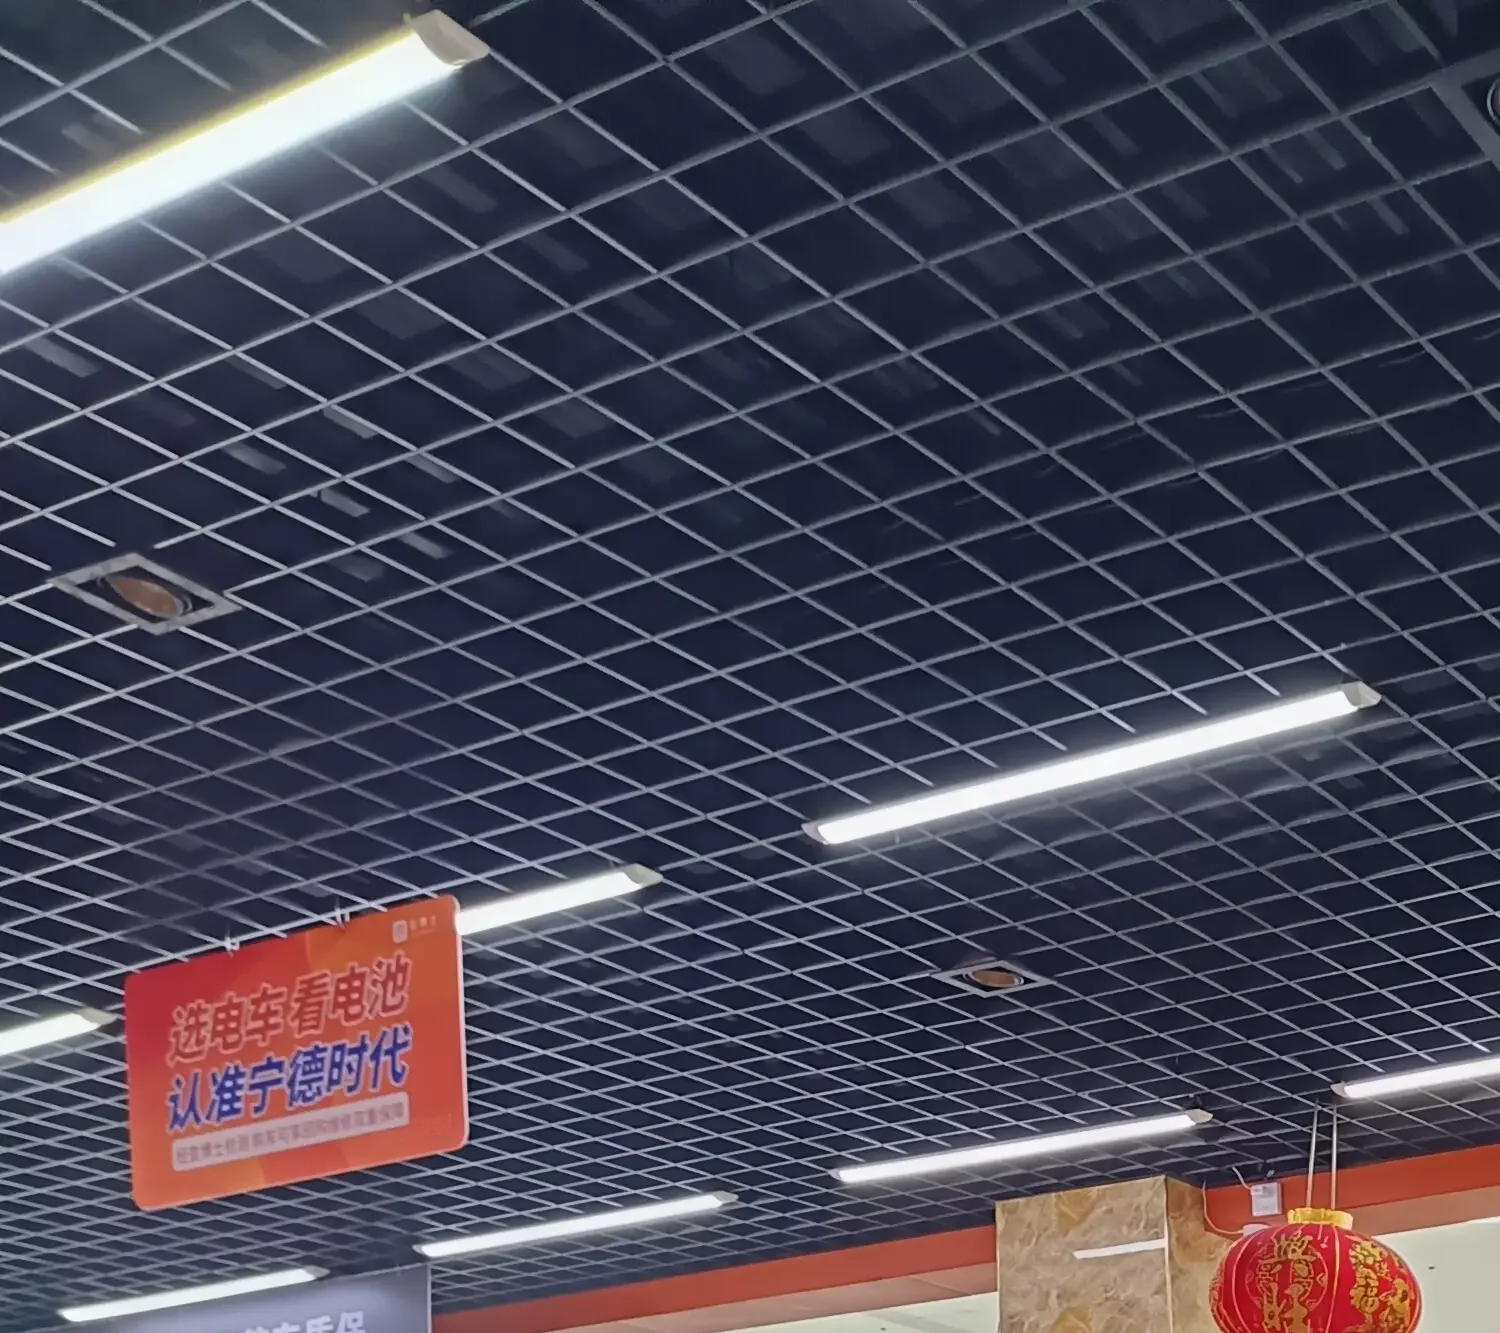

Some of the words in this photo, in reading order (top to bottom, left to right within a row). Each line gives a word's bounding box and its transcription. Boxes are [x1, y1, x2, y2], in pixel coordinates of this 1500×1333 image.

[166, 1024, 413, 1134] 认准宁德时代
